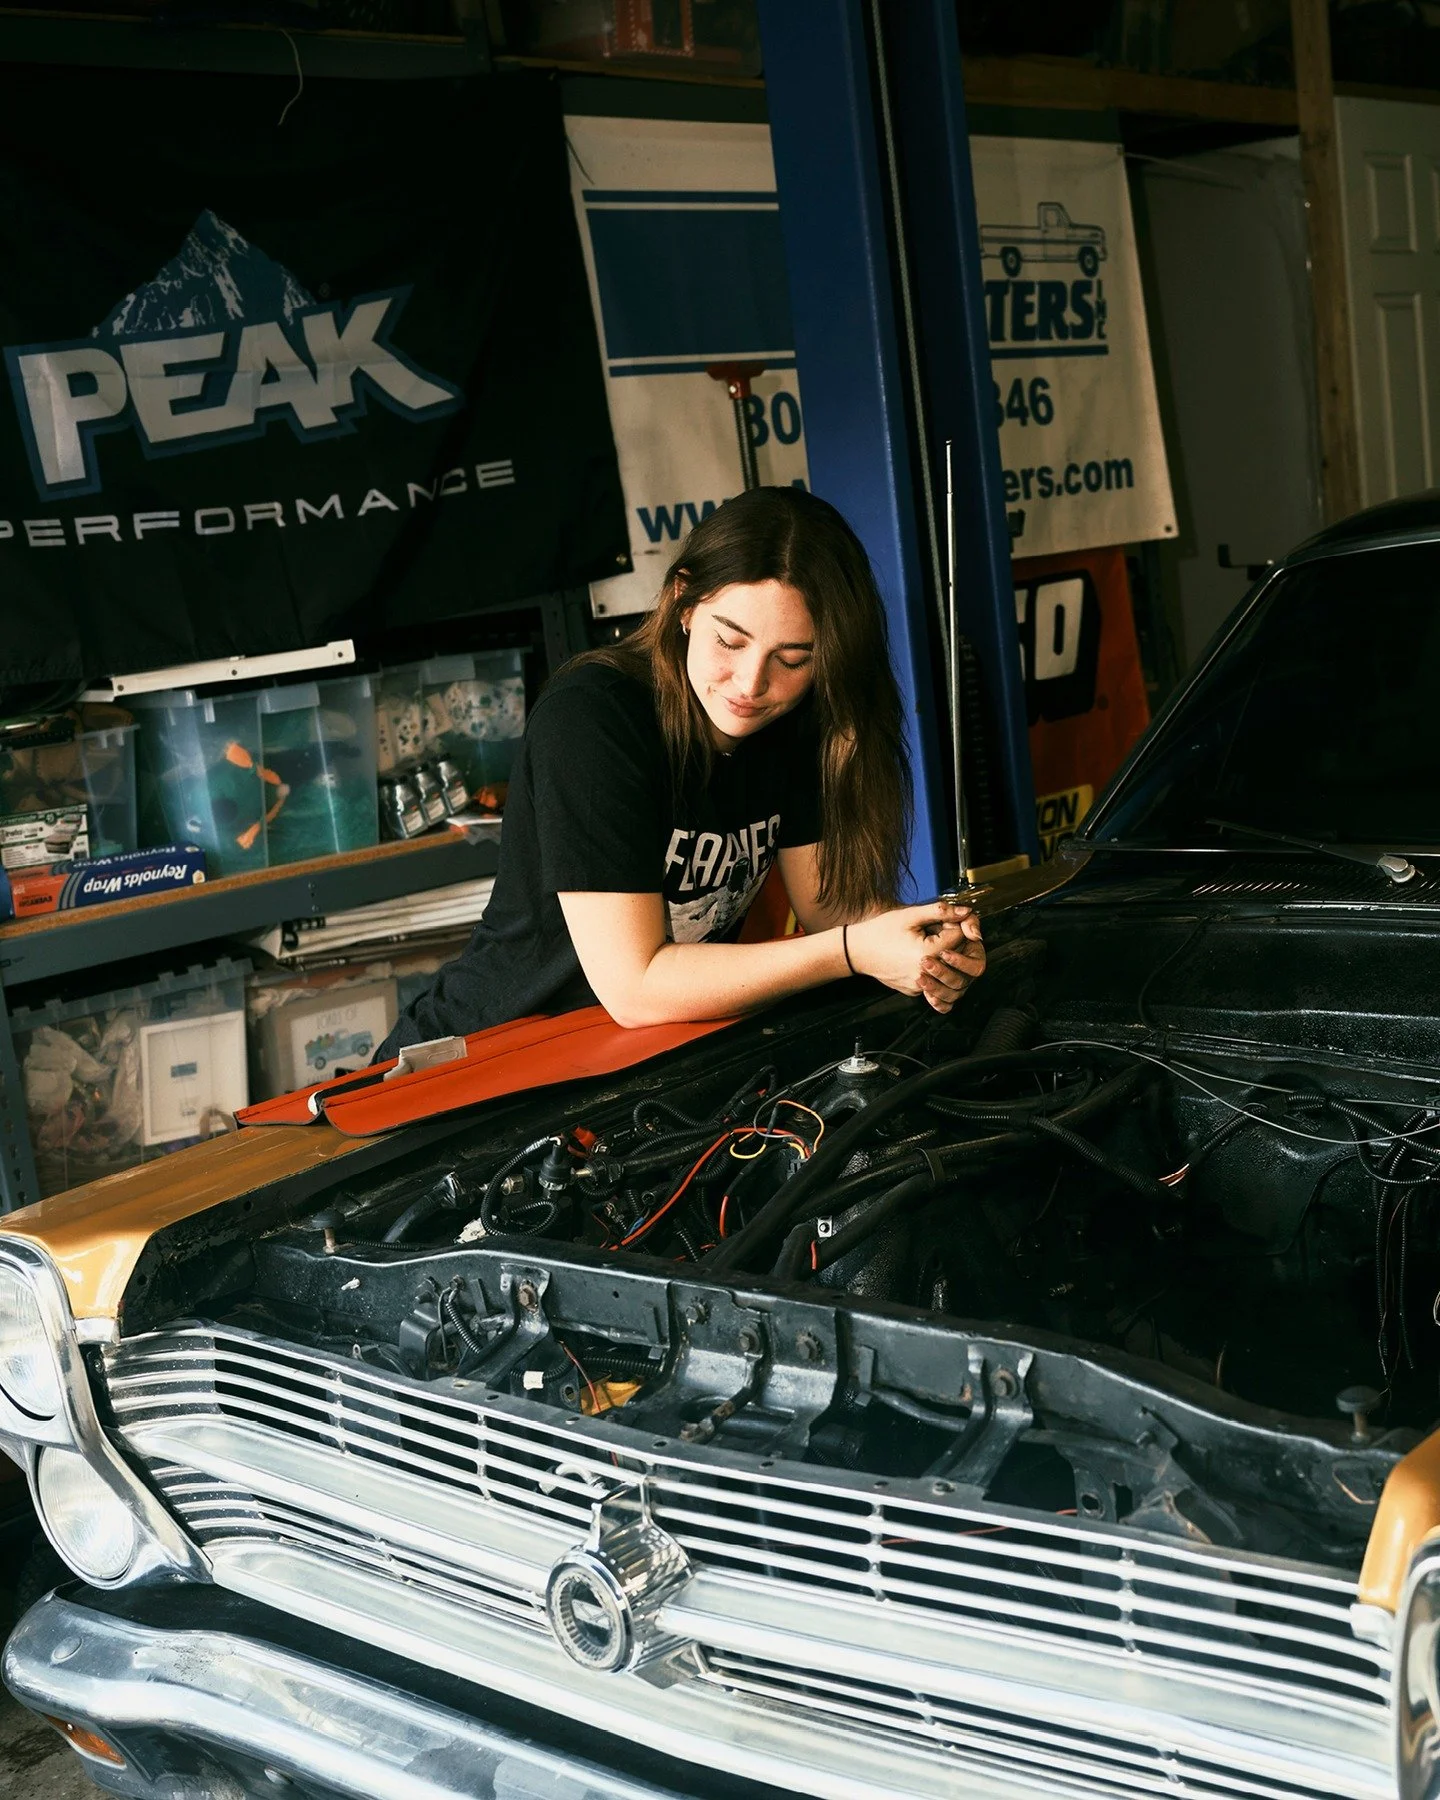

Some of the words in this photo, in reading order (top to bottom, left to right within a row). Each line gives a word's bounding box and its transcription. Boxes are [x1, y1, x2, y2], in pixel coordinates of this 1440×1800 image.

[18, 297, 456, 485] PEAK
[83, 873, 121, 894] Wrap
[123, 863, 188, 886] Reynolds
